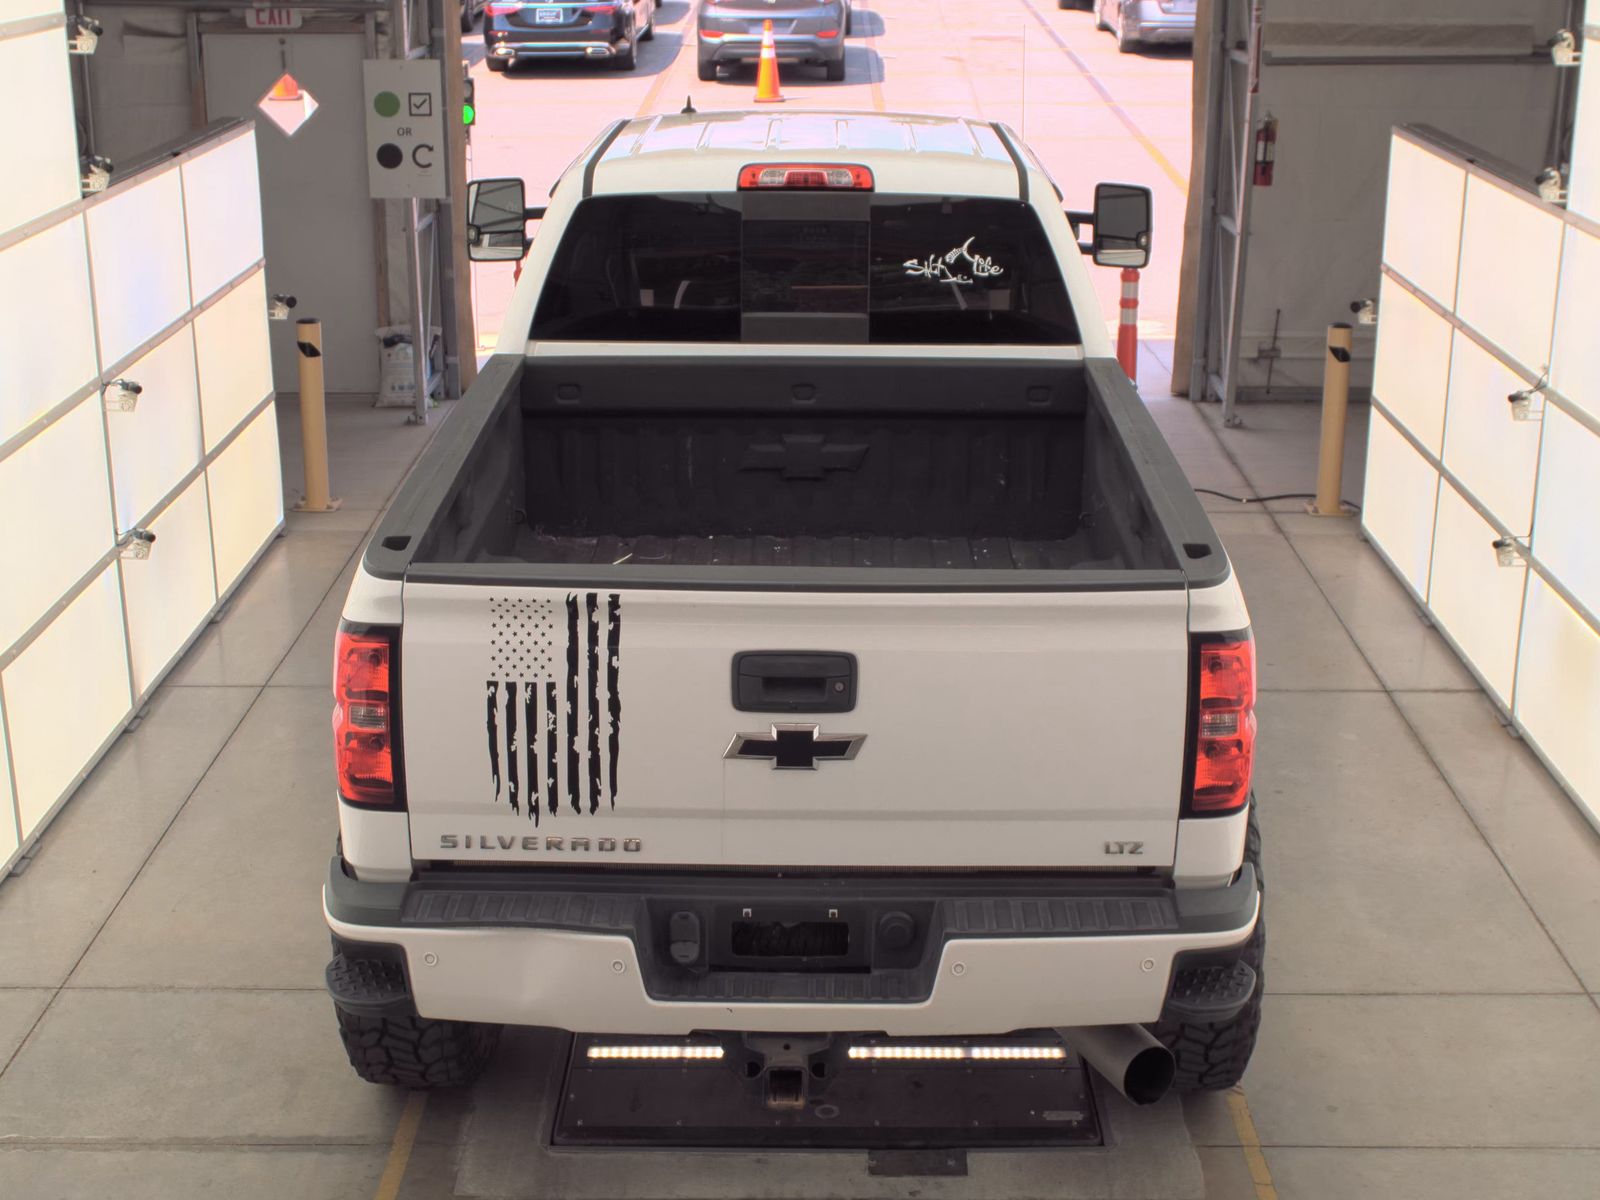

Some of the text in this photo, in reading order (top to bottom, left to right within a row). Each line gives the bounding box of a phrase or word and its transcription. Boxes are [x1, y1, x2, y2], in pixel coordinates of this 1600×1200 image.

[397, 127, 413, 137] OR
[439, 834, 642, 852] SILVERADO
[1104, 840, 1144, 855] LTZ
